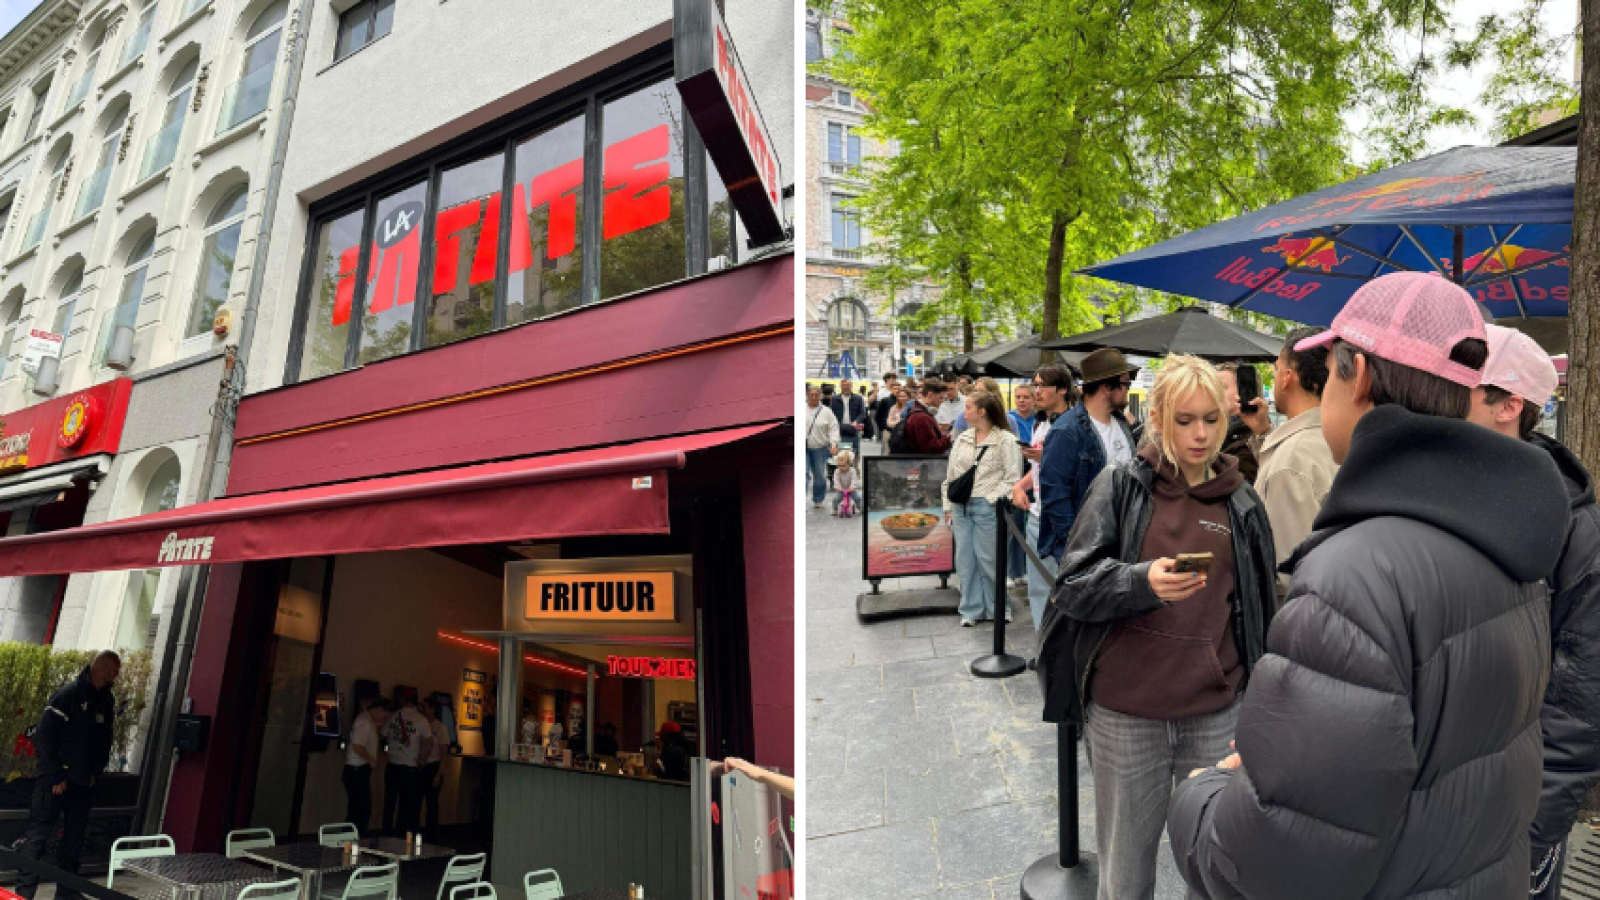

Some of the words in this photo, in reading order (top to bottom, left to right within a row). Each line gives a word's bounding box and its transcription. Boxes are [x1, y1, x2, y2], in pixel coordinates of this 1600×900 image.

[332, 123, 671, 327] PATATE
[1254, 200, 1364, 233] Red
[1366, 183, 1496, 210] Bull
[384, 209, 414, 243] LA
[158, 536, 215, 563] PATATE
[541, 581, 655, 612] FRITUUR
